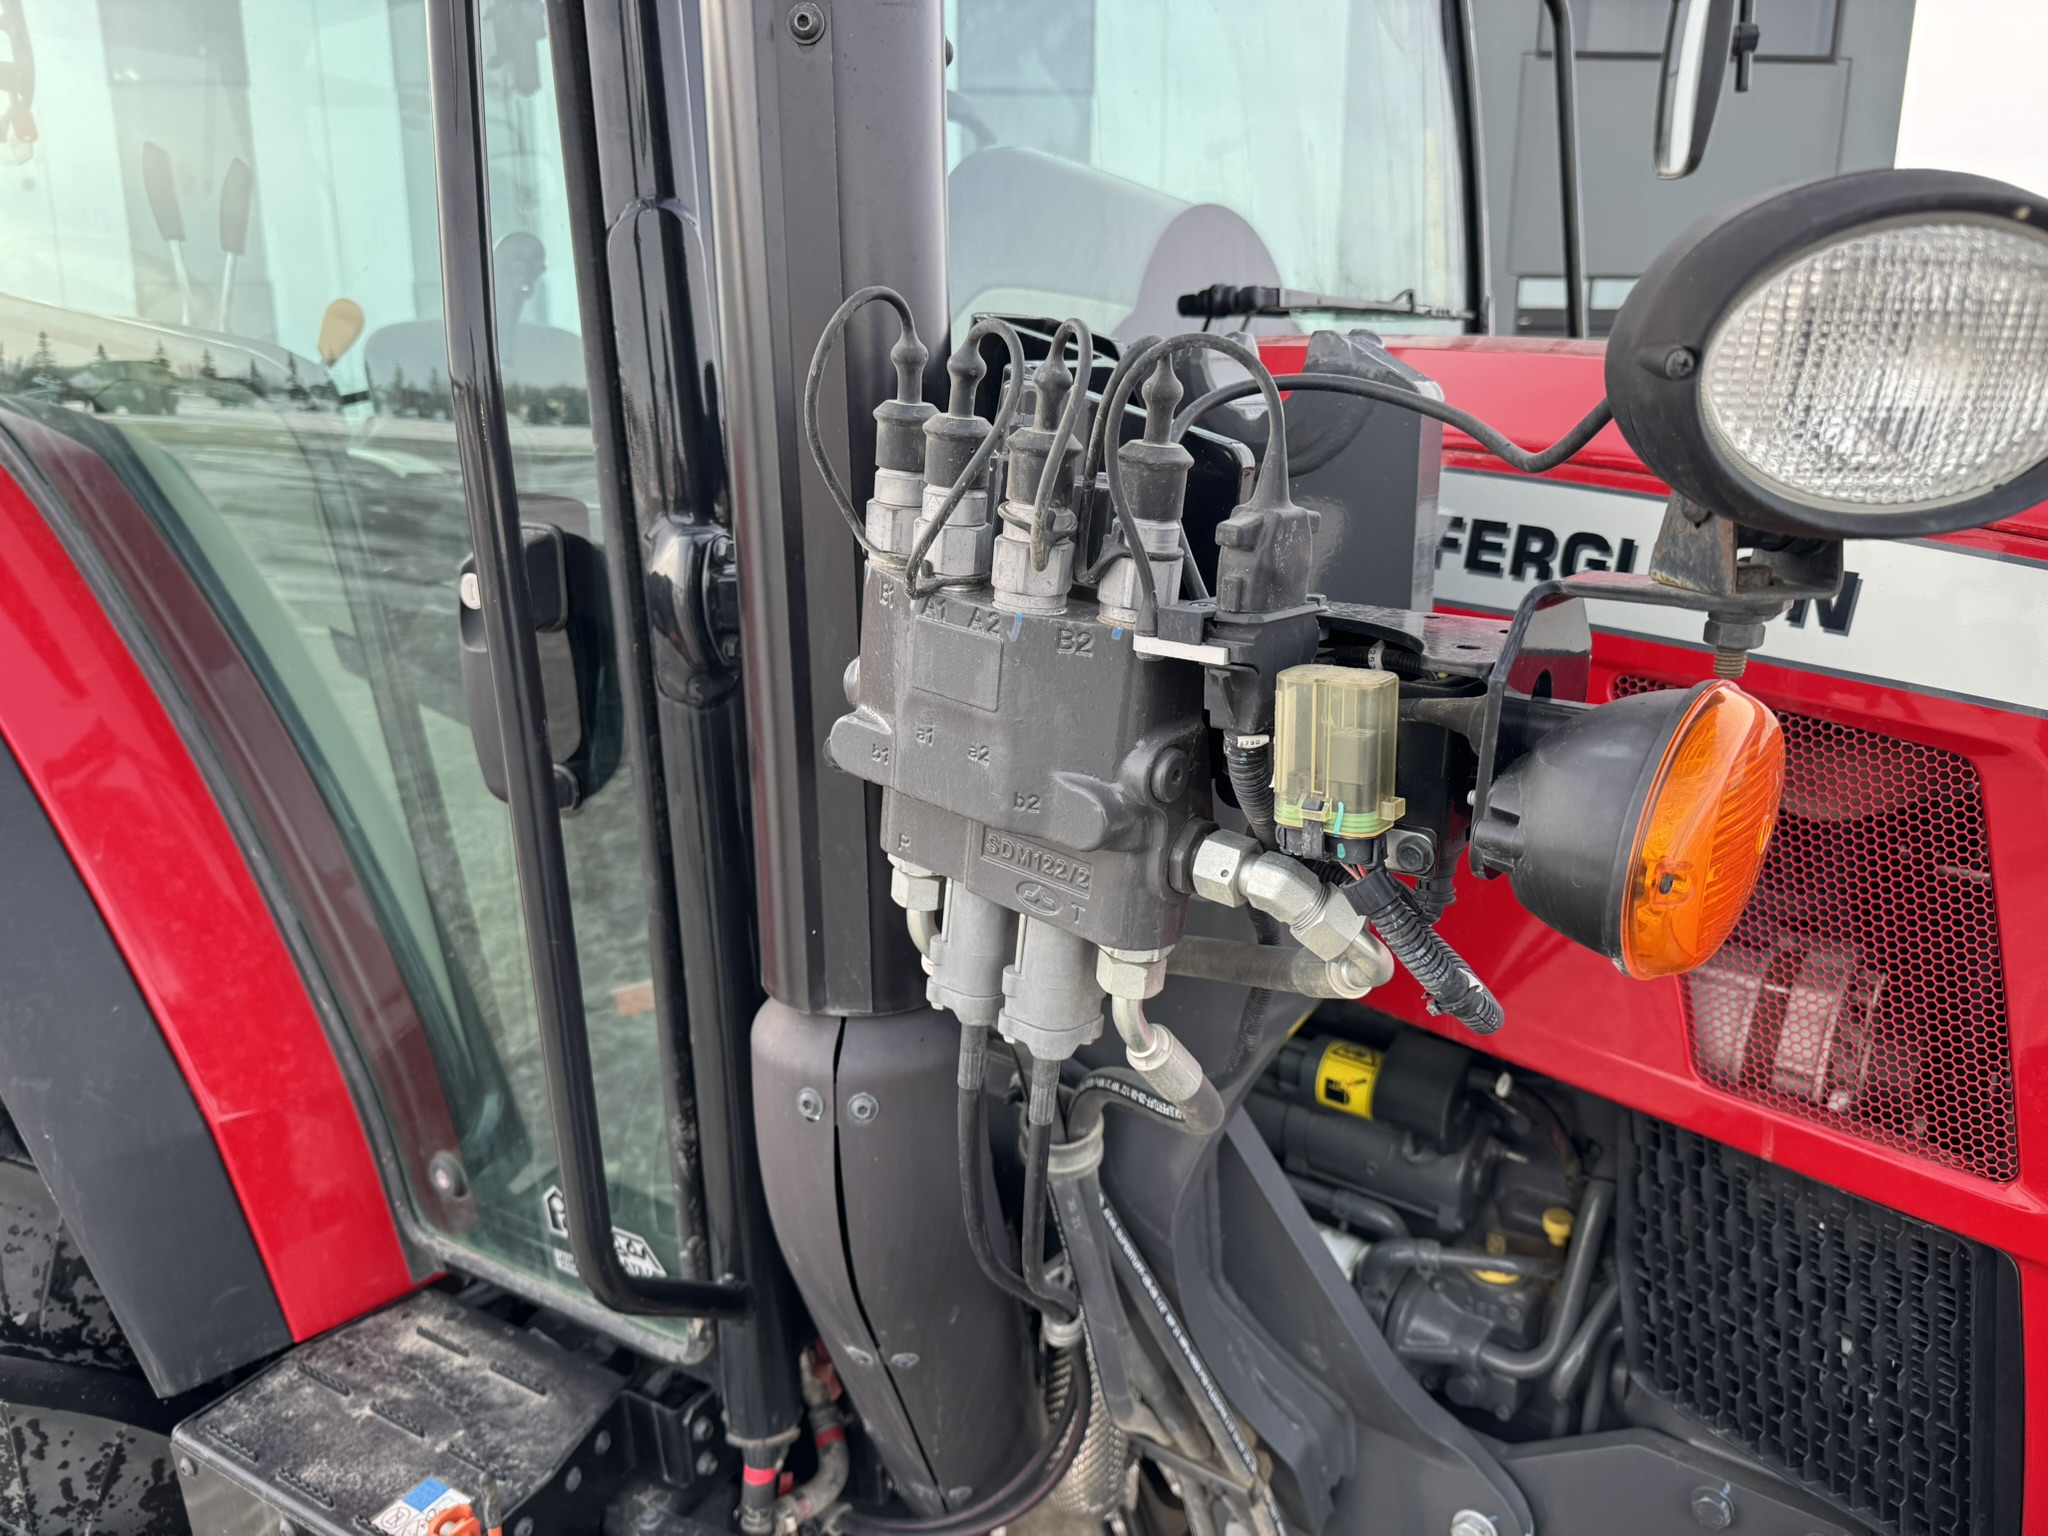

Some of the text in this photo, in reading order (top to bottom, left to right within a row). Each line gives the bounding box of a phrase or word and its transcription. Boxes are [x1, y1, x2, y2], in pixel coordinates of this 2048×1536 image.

[1435, 516, 1863, 636] FERGN
[921, 596, 947, 624] A1
[967, 607, 1001, 637] A2
[1055, 628, 1095, 658] B2
[916, 726, 934, 746] a1
[871, 743, 889, 765] b1
[967, 744, 991, 767] a2
[1013, 791, 1041, 814] b2
[986, 833, 1091, 889] SDM122/2
[1071, 902, 1086, 925] T
